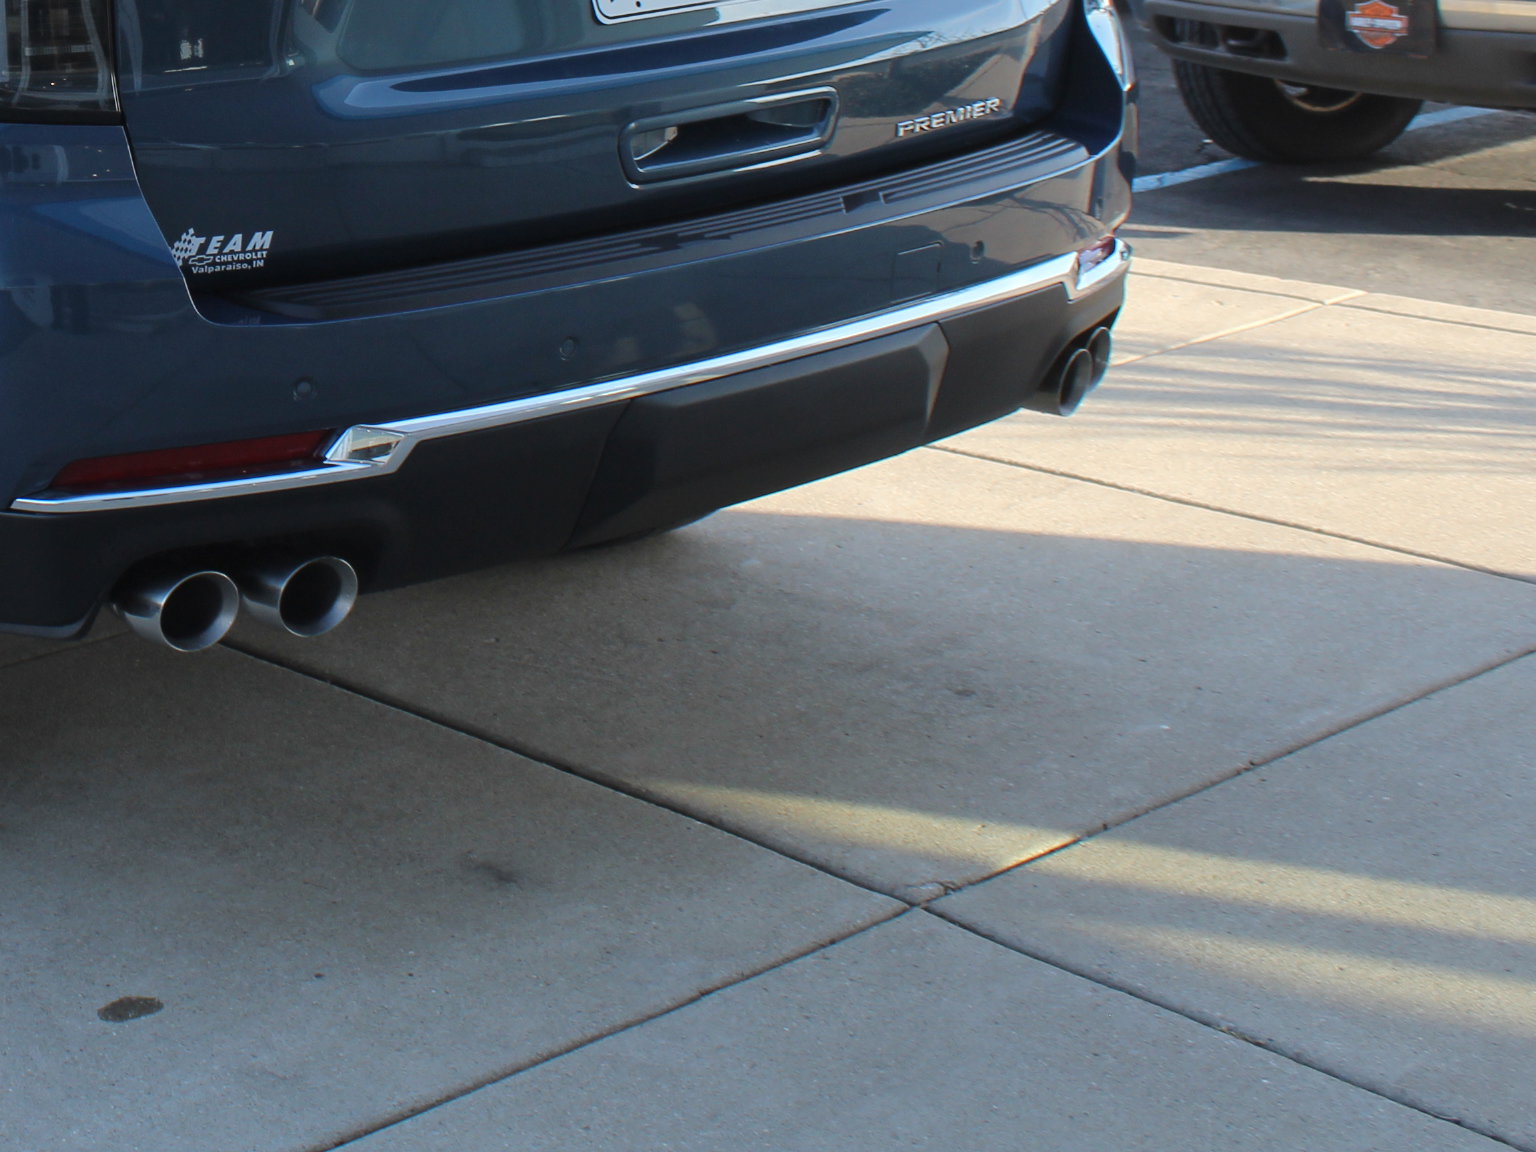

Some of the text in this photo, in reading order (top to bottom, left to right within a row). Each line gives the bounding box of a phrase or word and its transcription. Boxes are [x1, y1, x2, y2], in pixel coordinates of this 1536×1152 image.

[896, 97, 1001, 137] PREMIER
[188, 230, 274, 256] TEAM
[191, 259, 265, 275] Valparaiso, IN
[215, 250, 268, 263] CHEVROLET
